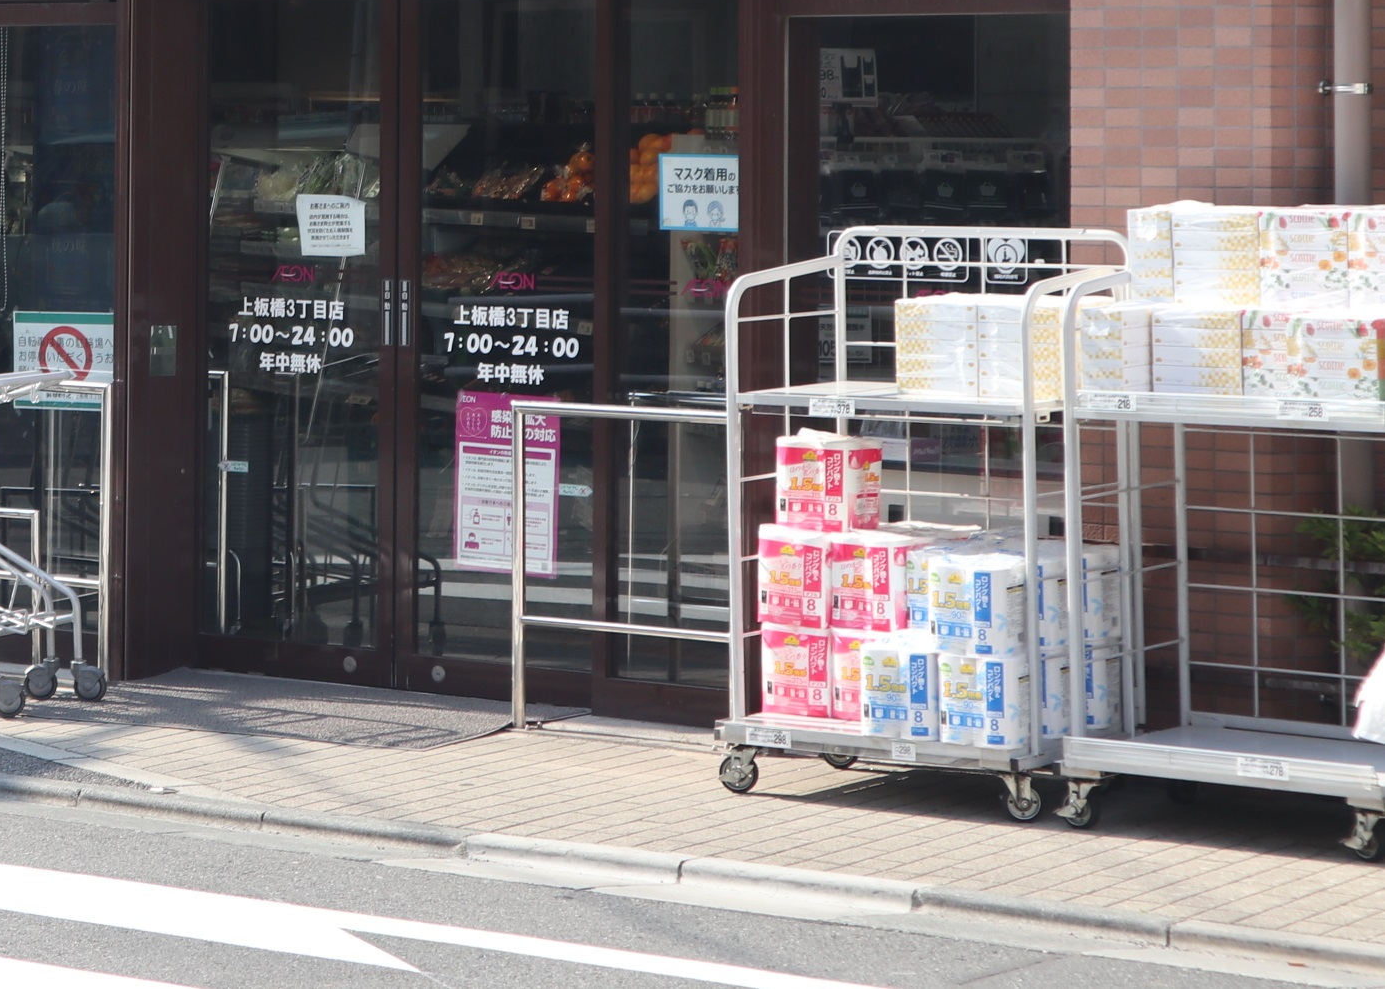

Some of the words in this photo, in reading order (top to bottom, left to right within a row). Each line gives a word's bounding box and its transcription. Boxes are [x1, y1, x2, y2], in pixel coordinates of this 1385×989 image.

[674, 167, 736, 182] マスク着用の
[238, 296, 345, 321] 上板橋3丁目店
[454, 304, 569, 330] 上板橋3丁目店
[259, 352, 322, 375] 年中無休
[477, 362, 545, 386] 年中無休
[837, 403, 851, 414] 378
[1117, 399, 1131, 409] 218
[1308, 406, 1323, 418] 258
[491, 410, 546, 427] 感染拡大
[490, 425, 556, 443] 防止の対応
[826, 457, 834, 490] コンパクト
[828, 504, 837, 515] 8
[807, 599, 816, 611] 8
[877, 602, 885, 615] 8
[978, 629, 986, 641] 8
[810, 643, 818, 675] コンパクト
[813, 689, 822, 701] 8
[914, 711, 923, 723] 8
[990, 719, 999, 731] 8
[773, 733, 787, 745] 298
[899, 745, 912, 755] 298
[1269, 765, 1284, 777] 278
